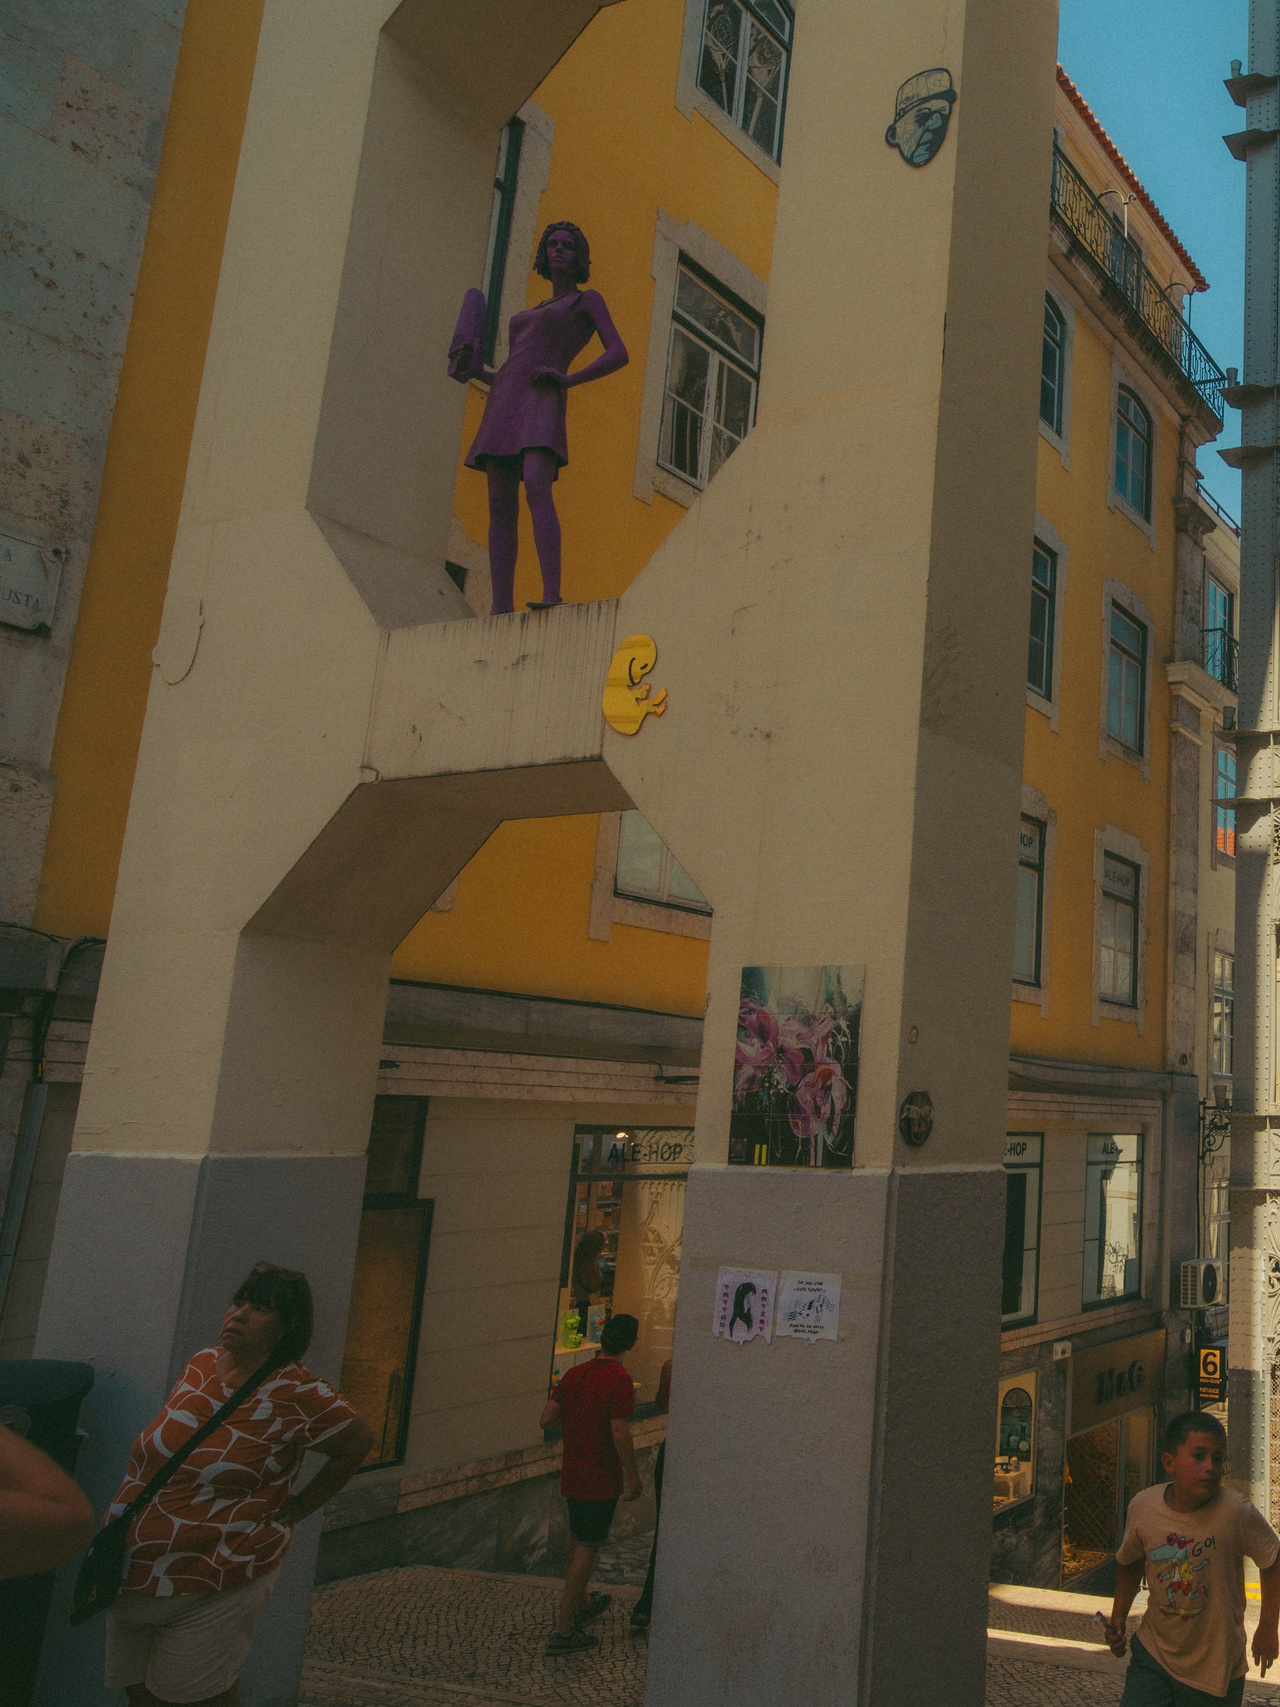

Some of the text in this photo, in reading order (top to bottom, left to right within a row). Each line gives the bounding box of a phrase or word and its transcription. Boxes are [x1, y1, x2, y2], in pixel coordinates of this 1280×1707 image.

[1, 587, 41, 613] USTA
[719, 1284, 729, 1328] TATTOO
[758, 1288, 768, 1333] ARTIST
[1202, 1351, 1218, 1376] 6
[1191, 1534, 1217, 1558] GO!
